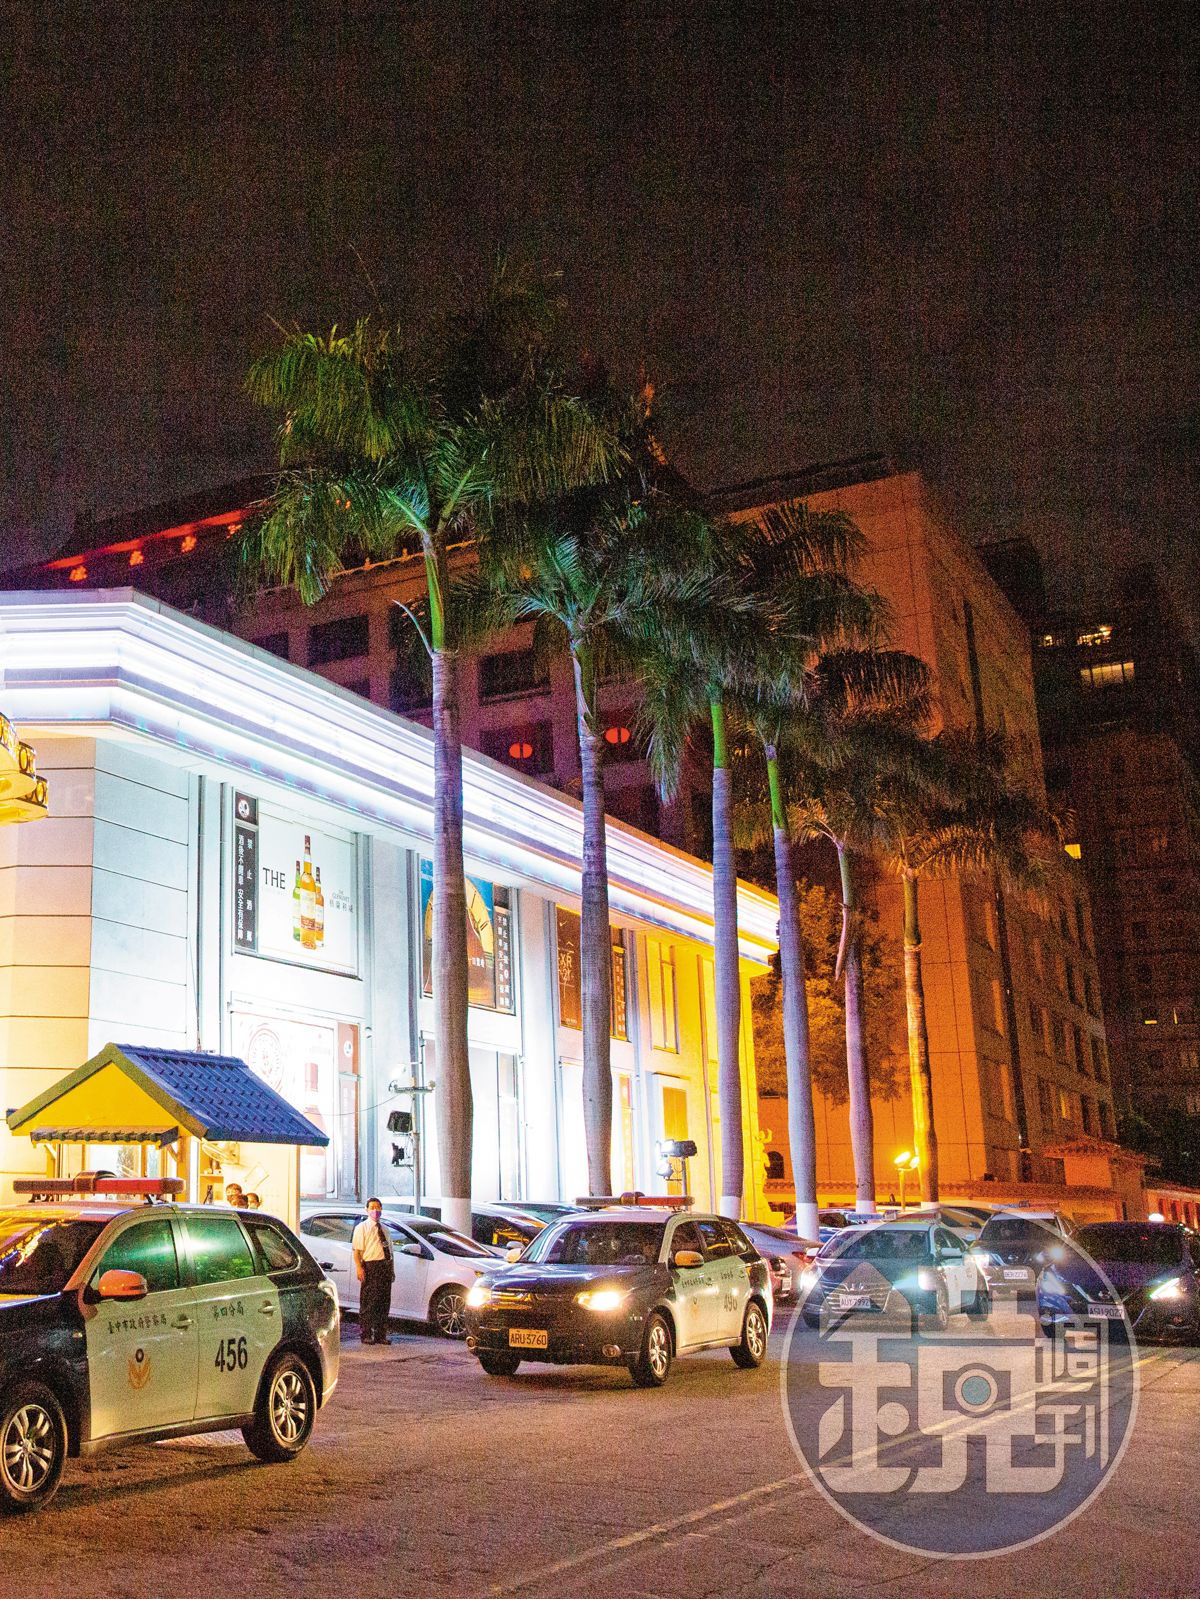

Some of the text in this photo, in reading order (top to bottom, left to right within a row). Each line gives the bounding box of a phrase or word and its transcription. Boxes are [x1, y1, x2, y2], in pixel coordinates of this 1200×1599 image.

[262, 867, 286, 889] THE
[211, 1301, 244, 1321] 第四分局
[215, 1336, 248, 1372] 456
